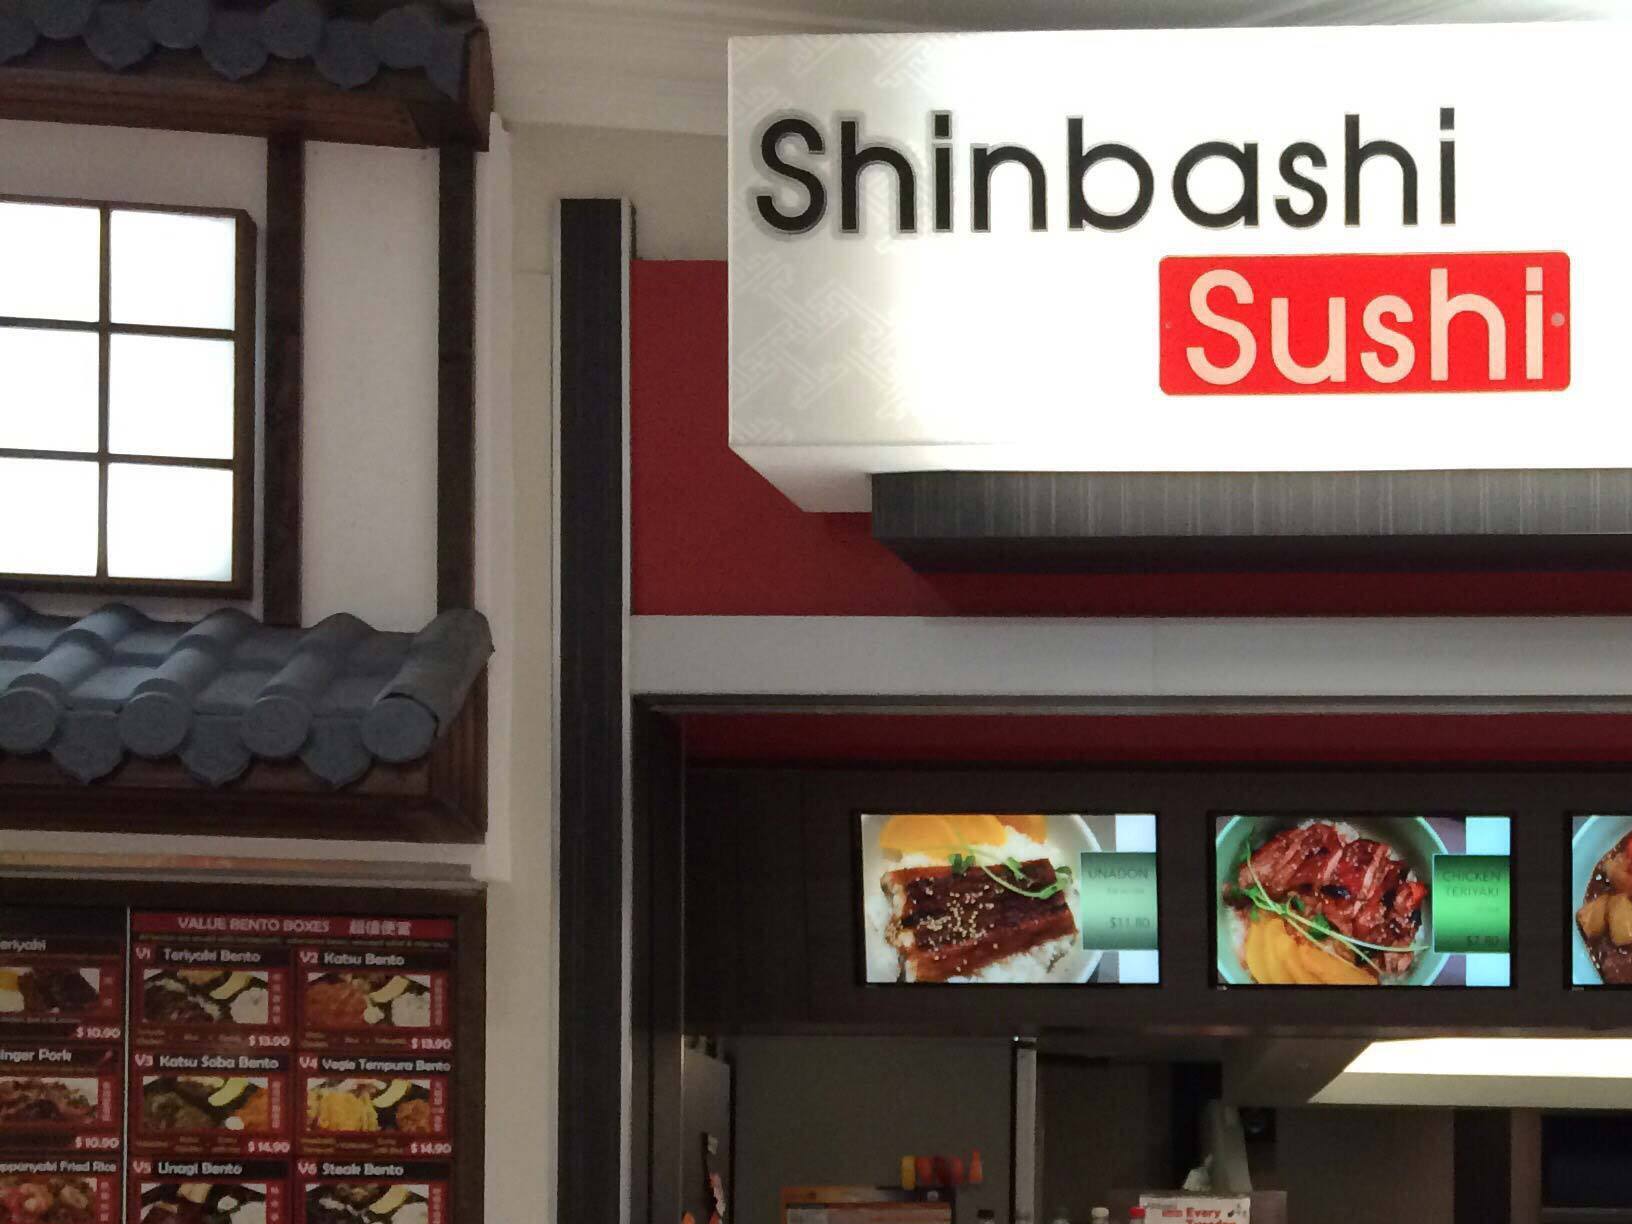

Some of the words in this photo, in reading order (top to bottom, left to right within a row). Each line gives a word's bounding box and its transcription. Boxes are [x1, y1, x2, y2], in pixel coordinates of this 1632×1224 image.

[755, 106, 1457, 233] Shinbashi
[1187, 267, 1546, 383] Sushi
[1087, 868, 1149, 880] UNADON
[1442, 871, 1501, 882] CHICKEN
[1445, 886, 1500, 897] TERIYAKI
[177, 917, 228, 930] VALUE
[230, 918, 280, 931] BENTO
[283, 919, 330, 932] BOXES
[163, 948, 217, 963] Teriyaki
[220, 949, 261, 962] Bento
[323, 953, 362, 965] Katsu
[364, 953, 405, 966] Bento
[38, 1048, 72, 1062] Pork
[159, 1055, 198, 1068] Katsu
[201, 1055, 235, 1068] Soba
[238, 1056, 280, 1069] Bento
[359, 1058, 413, 1073] Tempura
[415, 1059, 451, 1072] Bento
[60, 1160, 90, 1172] Fried
[92, 1161, 117, 1172] Rice
[158, 1162, 199, 1176] Unagi
[201, 1162, 243, 1175] Bento
[322, 1163, 362, 1176] Steak
[364, 1163, 404, 1176] Bento
